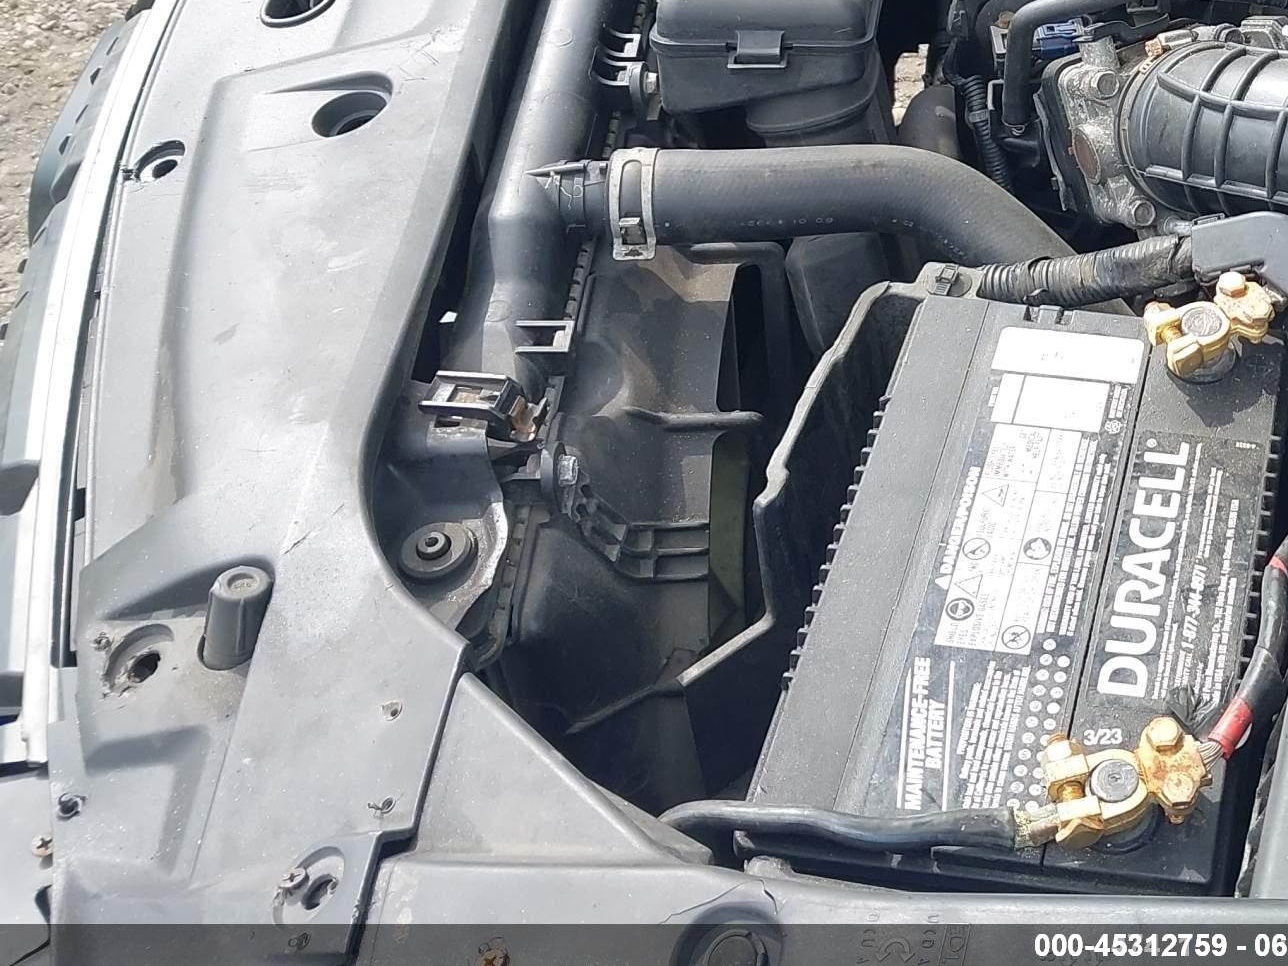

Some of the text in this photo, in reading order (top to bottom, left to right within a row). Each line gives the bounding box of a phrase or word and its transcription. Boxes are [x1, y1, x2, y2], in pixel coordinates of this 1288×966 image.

[1097, 441, 1189, 698] DURACELL
[905, 657, 930, 810] MAINTENANCE-FREE
[925, 698, 945, 769] BATTERY
[1083, 728, 1123, 745] 3/23
